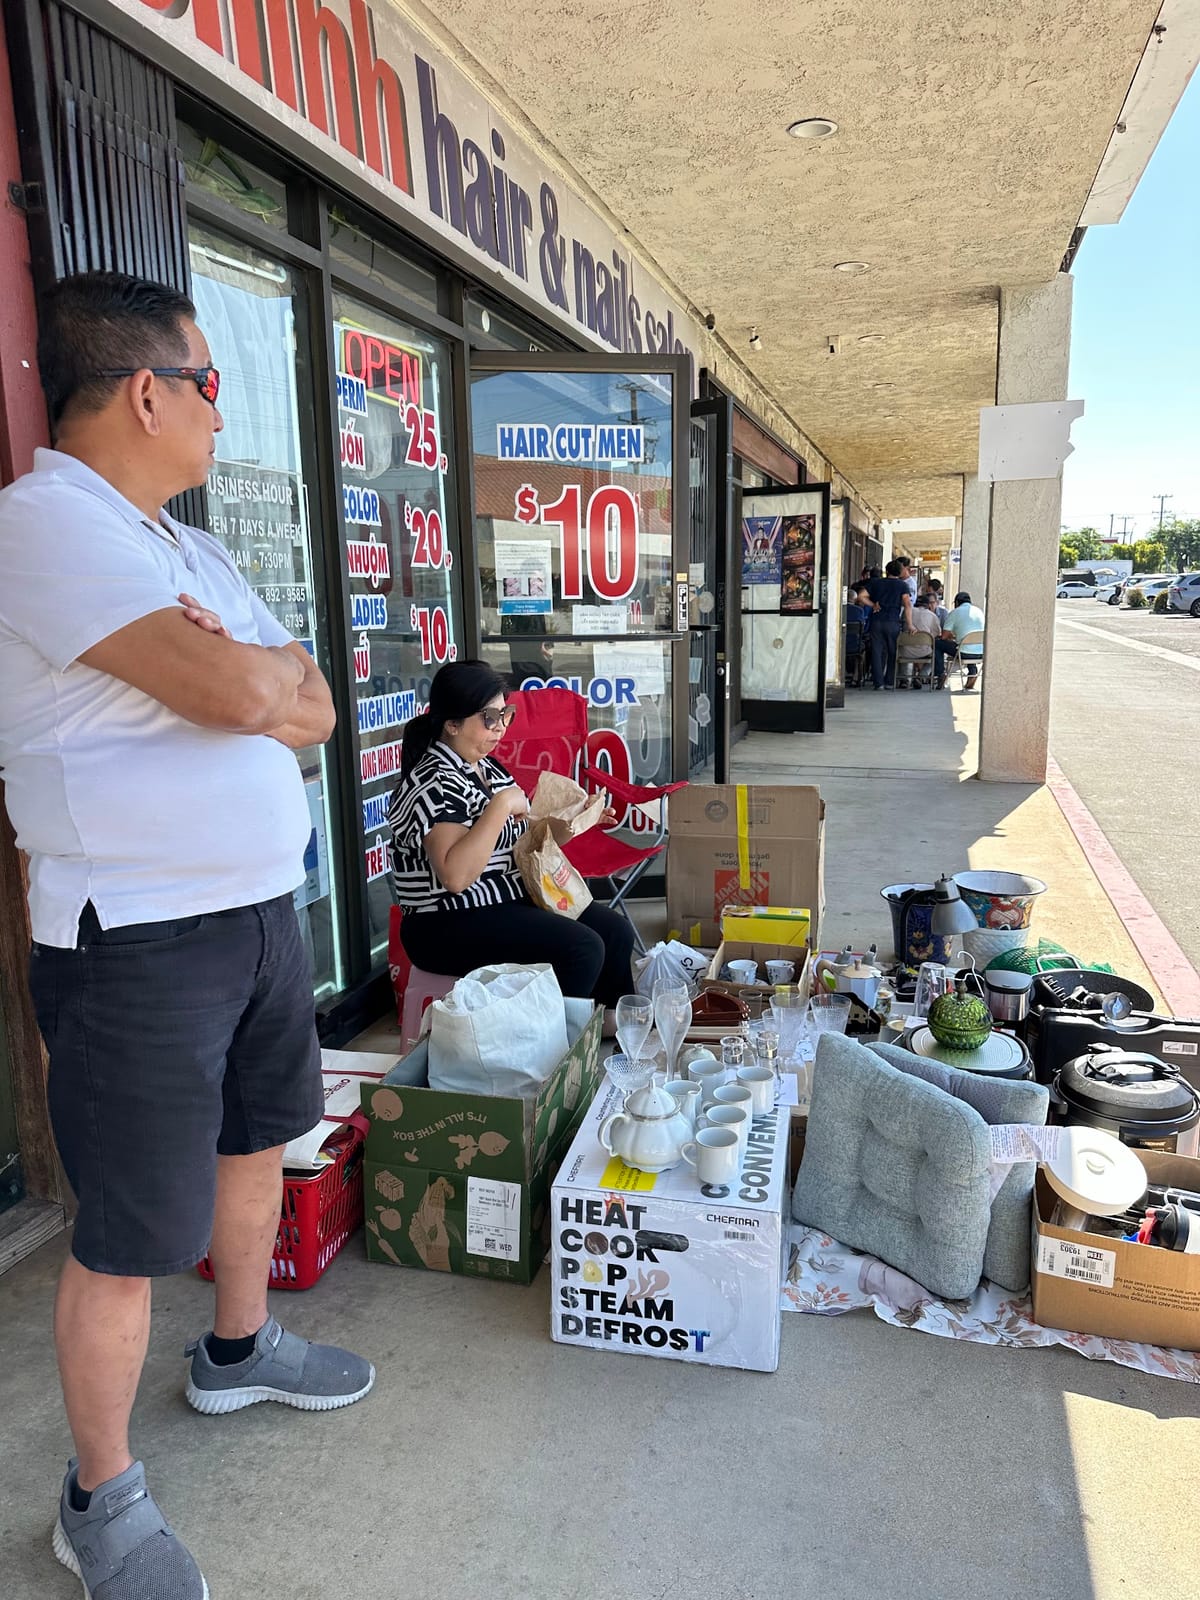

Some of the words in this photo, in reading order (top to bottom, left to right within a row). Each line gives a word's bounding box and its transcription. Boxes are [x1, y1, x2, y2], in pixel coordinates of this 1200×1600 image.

[415, 53, 533, 283] hair
[539, 182, 570, 313] &
[345, 330, 420, 405] OPEN
[500, 427, 550, 459] HAIR
[556, 427, 593, 459] CUT
[599, 428, 641, 459] MEN
[206, 474, 262, 501] USINESS
[262, 484, 294, 506] HOUR
[208, 515, 228, 535] PEN
[231, 518, 237, 535] 7
[240, 518, 265, 537] DAYS
[259, 551, 292, 569] 7:30PM
[679, 588, 687, 620] PULL
[358, 700, 384, 731] HIGH
[386, 693, 415, 726] LIGHT
[361, 750, 377, 782] ONG
[378, 745, 395, 777] HAIR
[434, 1119, 447, 1131] IN
[445, 1112, 465, 1125] ALL
[466, 1112, 488, 1124] IT'S
[392, 1130, 415, 1142] BOX
[415, 1125, 437, 1139] THE
[567, 1154, 586, 1182] CHEFMAN
[560, 1196, 648, 1230] HEAT
[706, 1213, 760, 1228] CHEFMAN
[560, 1286, 674, 1322] STEAM
[1088, 1287, 1130, 1300] INSTRUCTIONS
[1130, 1296, 1158, 1306] SHIPPING
[1158, 1300, 1170, 1308] AND
[560, 1313, 711, 1353] DEFROST
